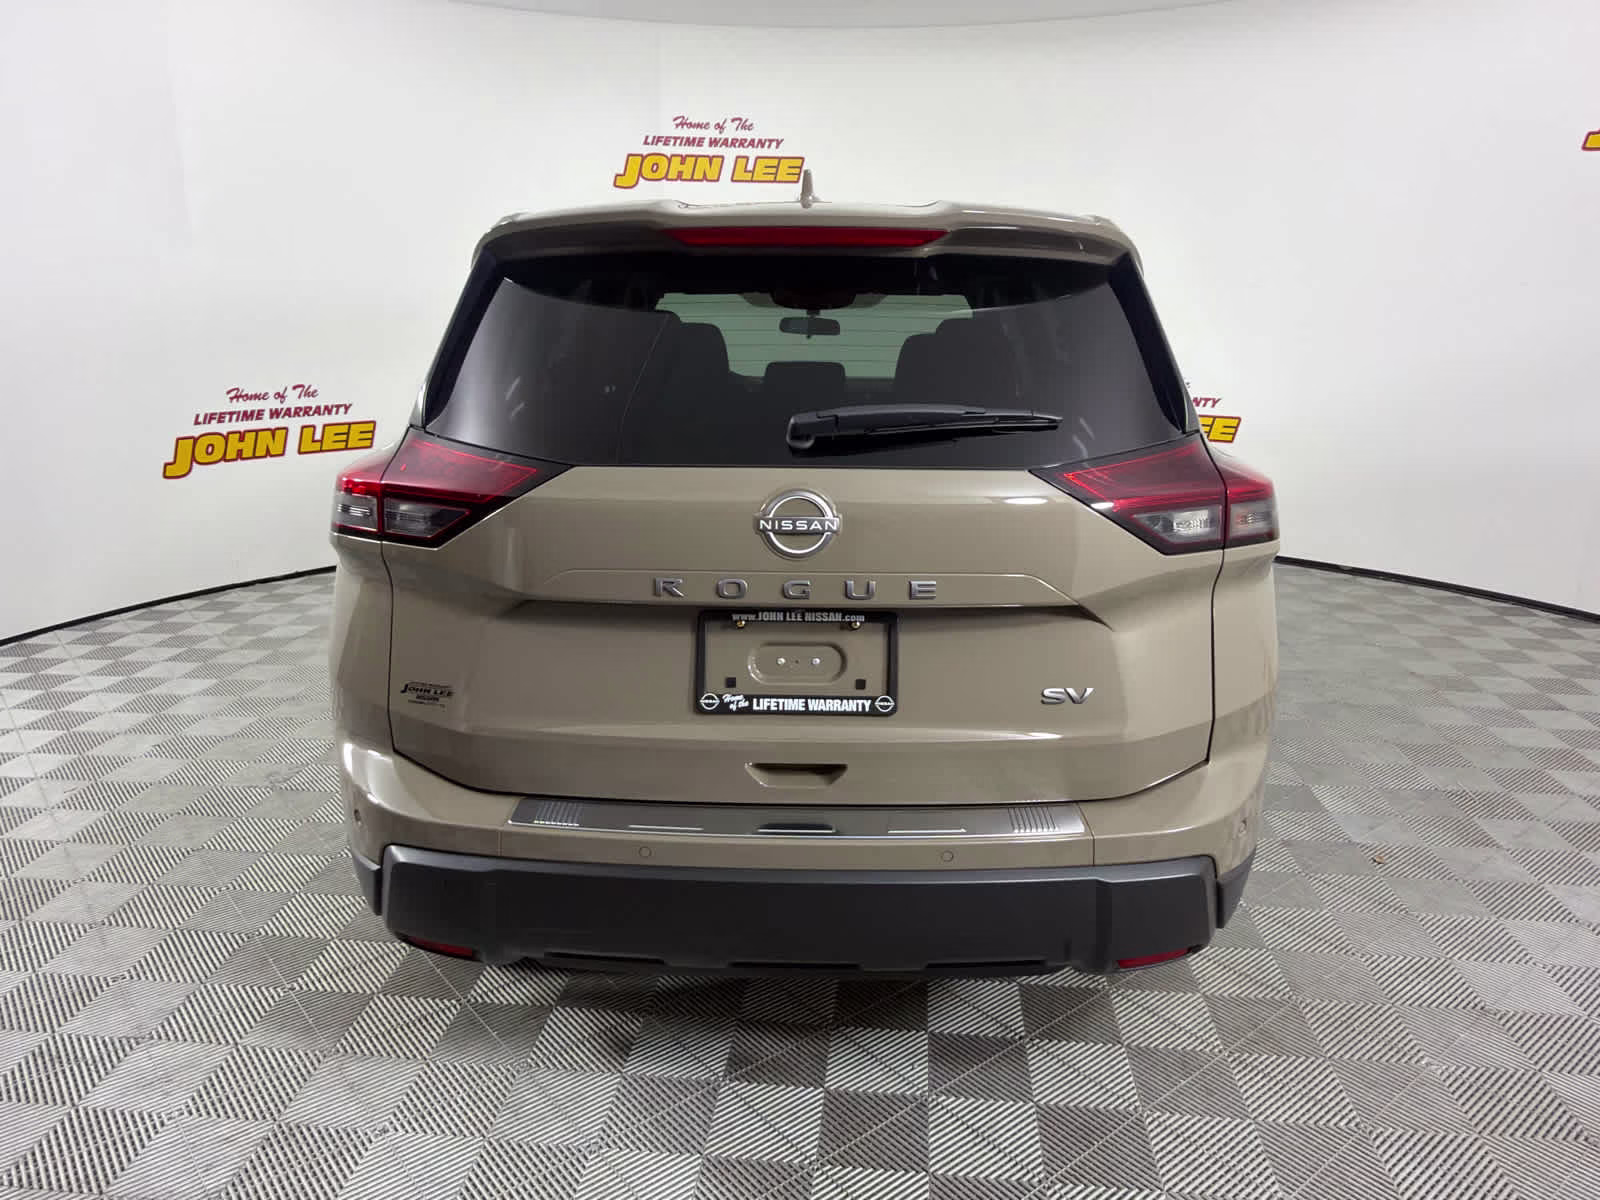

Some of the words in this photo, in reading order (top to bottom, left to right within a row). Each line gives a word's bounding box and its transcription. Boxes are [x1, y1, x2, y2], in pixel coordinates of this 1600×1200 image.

[672, 115, 710, 130] Home
[714, 118, 727, 134] of
[731, 117, 754, 132] The
[642, 135, 705, 148] LIFETIME
[708, 137, 785, 150] WARRANTY
[613, 153, 724, 190] JOHN
[730, 155, 805, 184] LEE
[226, 387, 270, 403] Home
[273, 387, 287, 404] of
[292, 383, 319, 399] The
[193, 408, 265, 426] LIFETIME
[269, 403, 353, 419] WARRANTY
[162, 426, 289, 480] JOHN
[297, 420, 377, 455] LEE
[759, 519, 838, 531] NISSAN
[652, 576, 937, 601] ROGUE
[786, 612, 804, 622] LEE
[752, 698, 806, 711] LIFETIME
[807, 699, 872, 712] WARRANTY
[1041, 687, 1095, 705] SV
